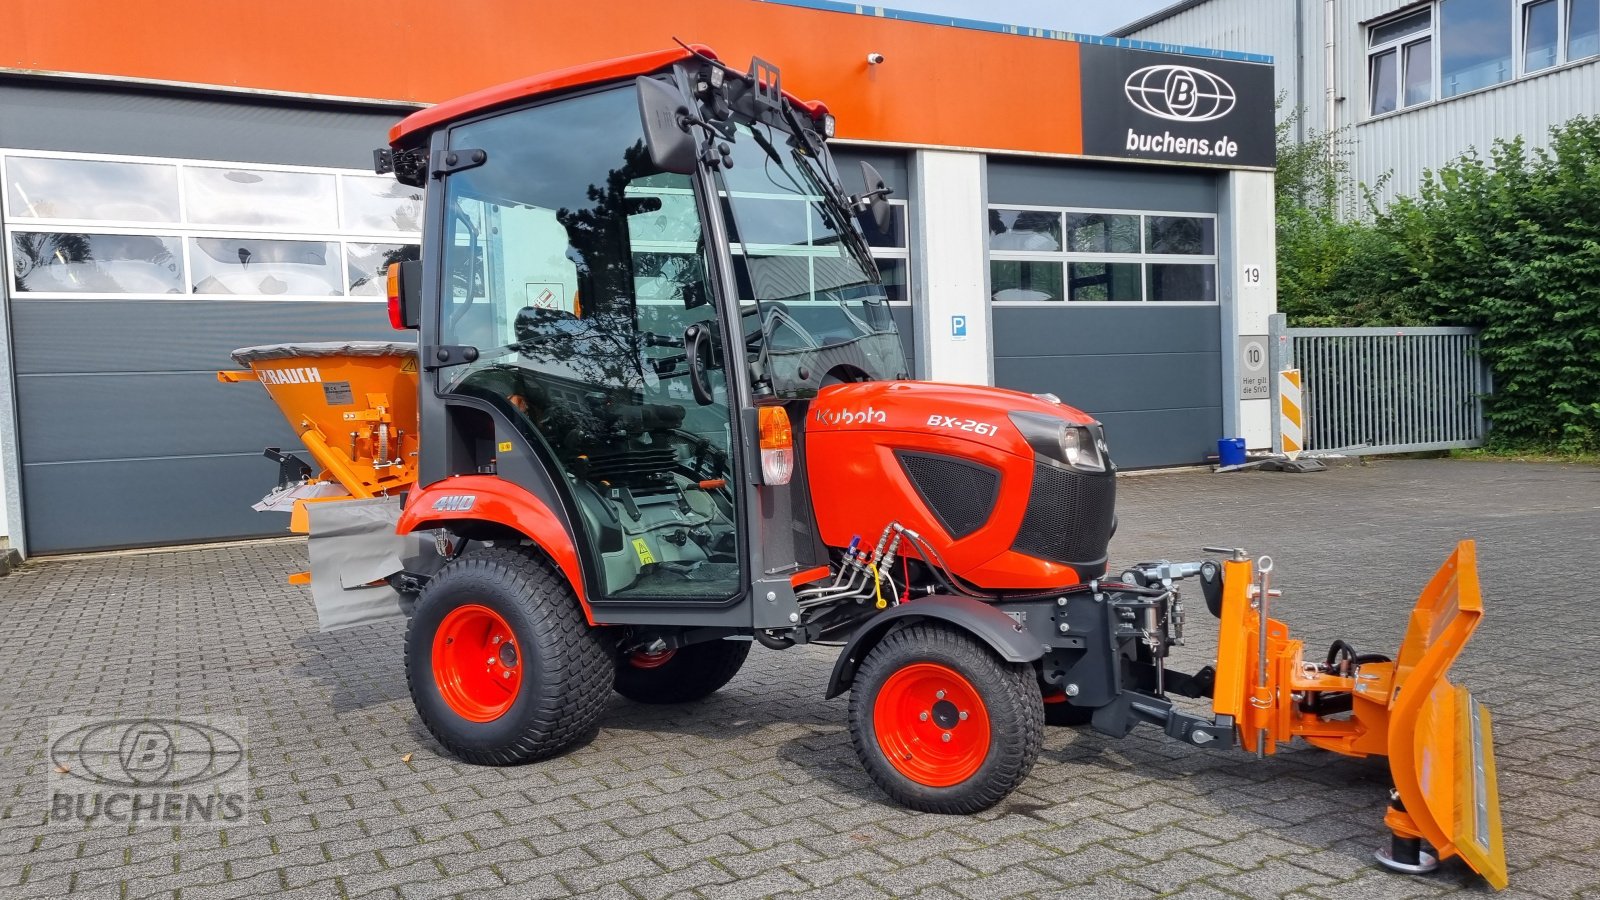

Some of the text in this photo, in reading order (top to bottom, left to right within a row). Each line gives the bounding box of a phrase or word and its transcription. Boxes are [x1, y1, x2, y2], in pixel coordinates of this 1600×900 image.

[1168, 75, 1196, 109] B
[1126, 128, 1238, 157] buchens.de
[1244, 267, 1260, 283] 19
[953, 317, 965, 335] P
[1248, 349, 1260, 363] 10
[266, 367, 322, 385] RAUCH
[1242, 377, 1256, 385] Hier
[1242, 386, 1253, 394] die
[815, 406, 887, 425] Kubota
[926, 414, 999, 437] BX-261
[432, 495, 477, 511] 4WD
